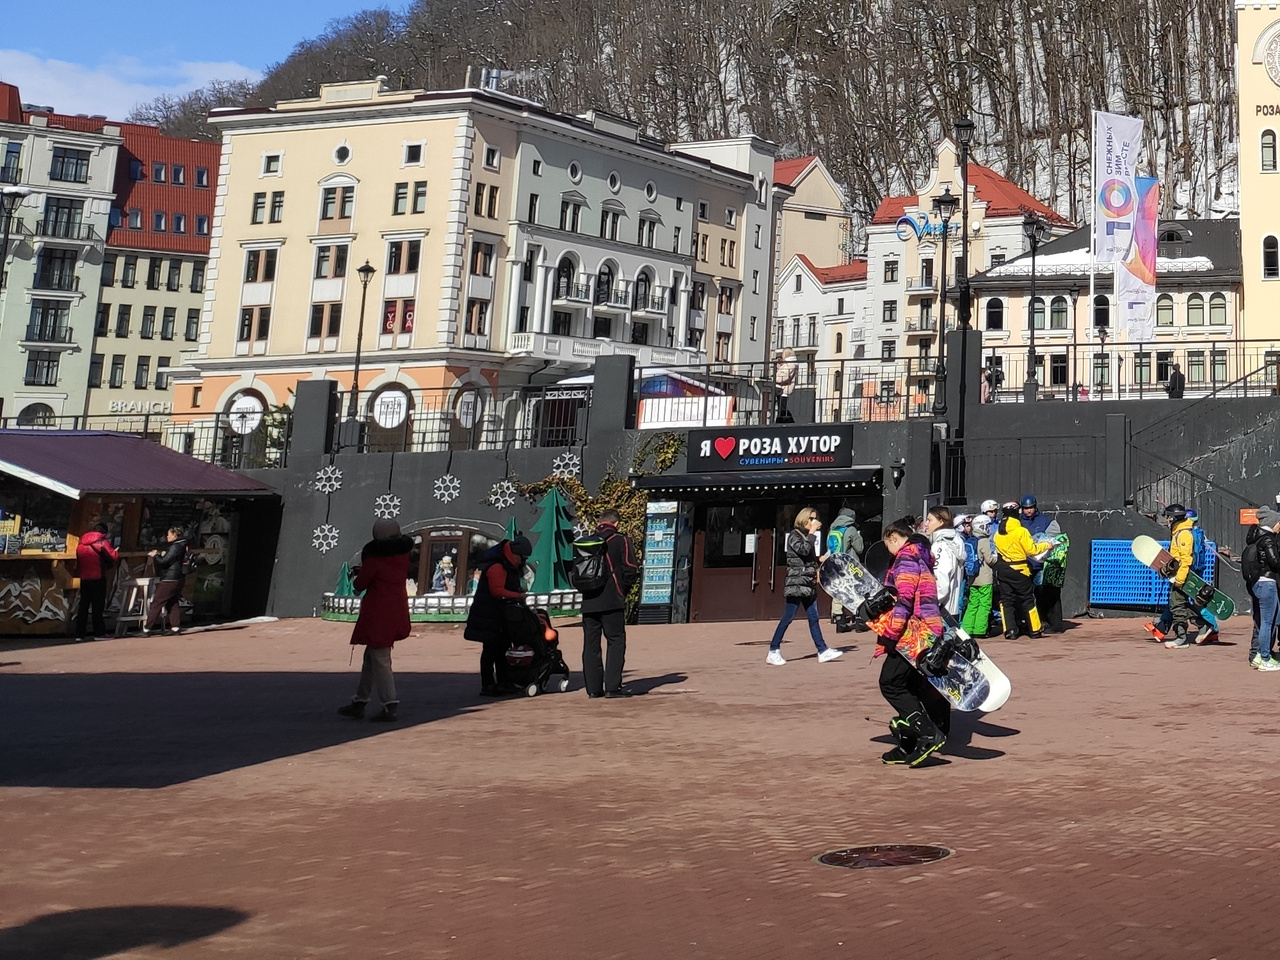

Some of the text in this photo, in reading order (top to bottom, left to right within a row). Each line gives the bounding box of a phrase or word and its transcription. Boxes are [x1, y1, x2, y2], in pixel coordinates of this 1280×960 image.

[1255, 104, 1280, 117] РОЗА
[1114, 155, 1122, 176] ЗИМ
[109, 400, 173, 414] BRANCH
[700, 435, 841, 457] Я РОЗА ХУТОР
[739, 456, 835, 466] СУВЕНИРЫ SOUVENIRS
